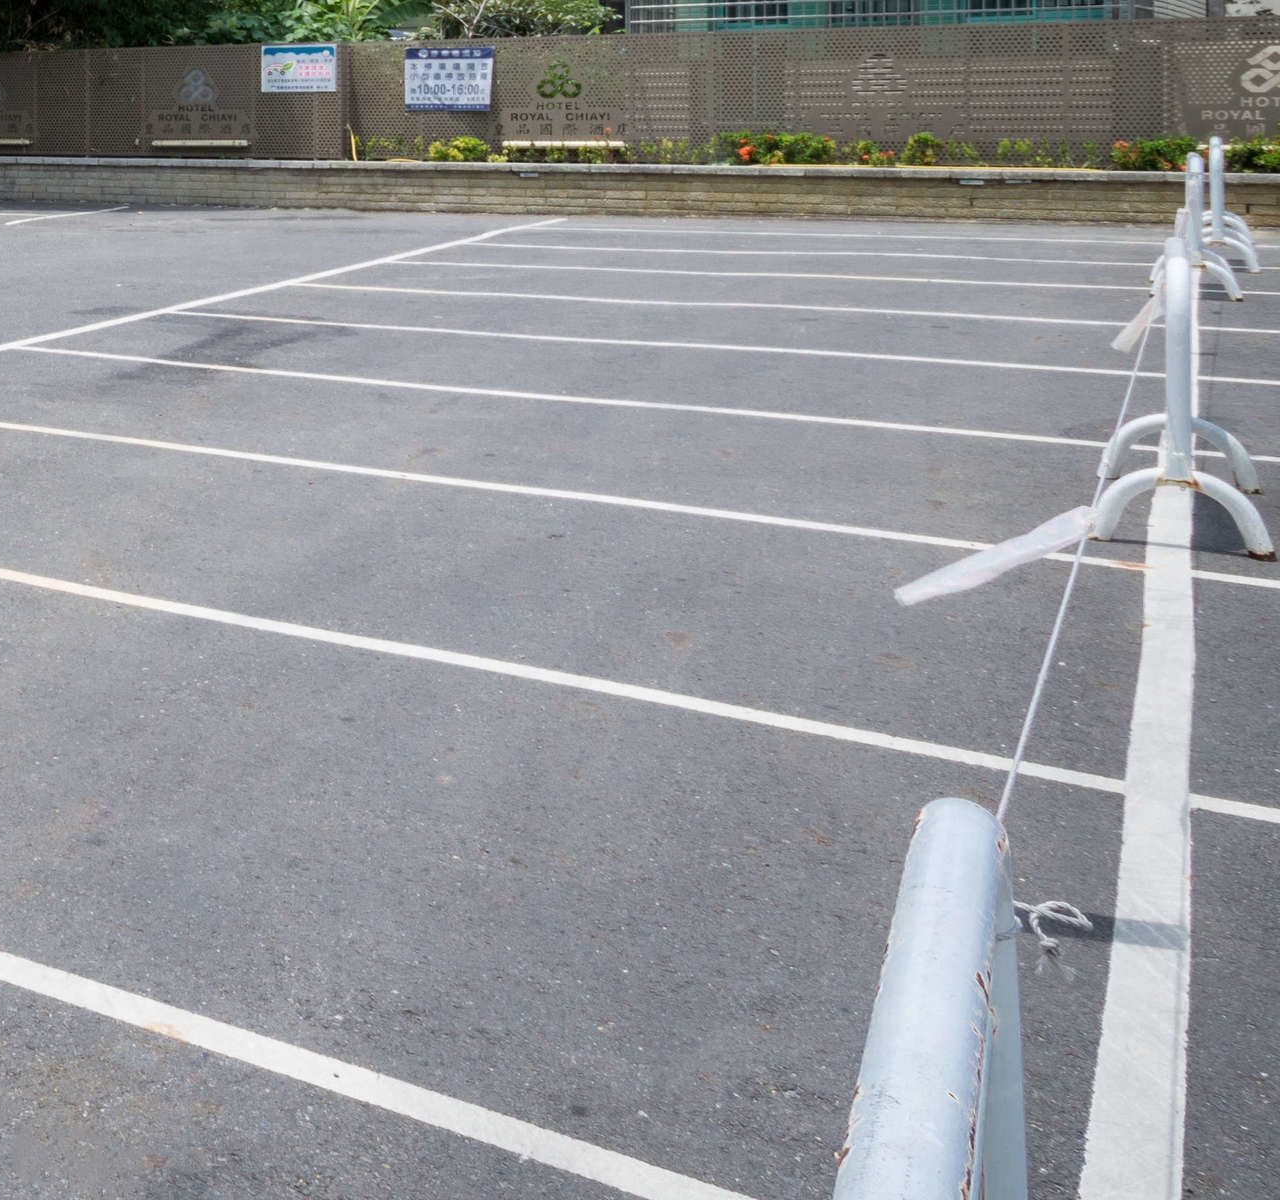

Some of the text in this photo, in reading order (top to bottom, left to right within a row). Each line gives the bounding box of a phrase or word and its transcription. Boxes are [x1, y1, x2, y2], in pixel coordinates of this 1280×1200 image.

[178, 104, 214, 112] HOTEL
[536, 102, 580, 110] HOTEL
[158, 113, 237, 122] ROYAL CHIAYI
[510, 113, 610, 121] ROYAL CHIAYI
[1201, 110, 1265, 120] ROYAL
